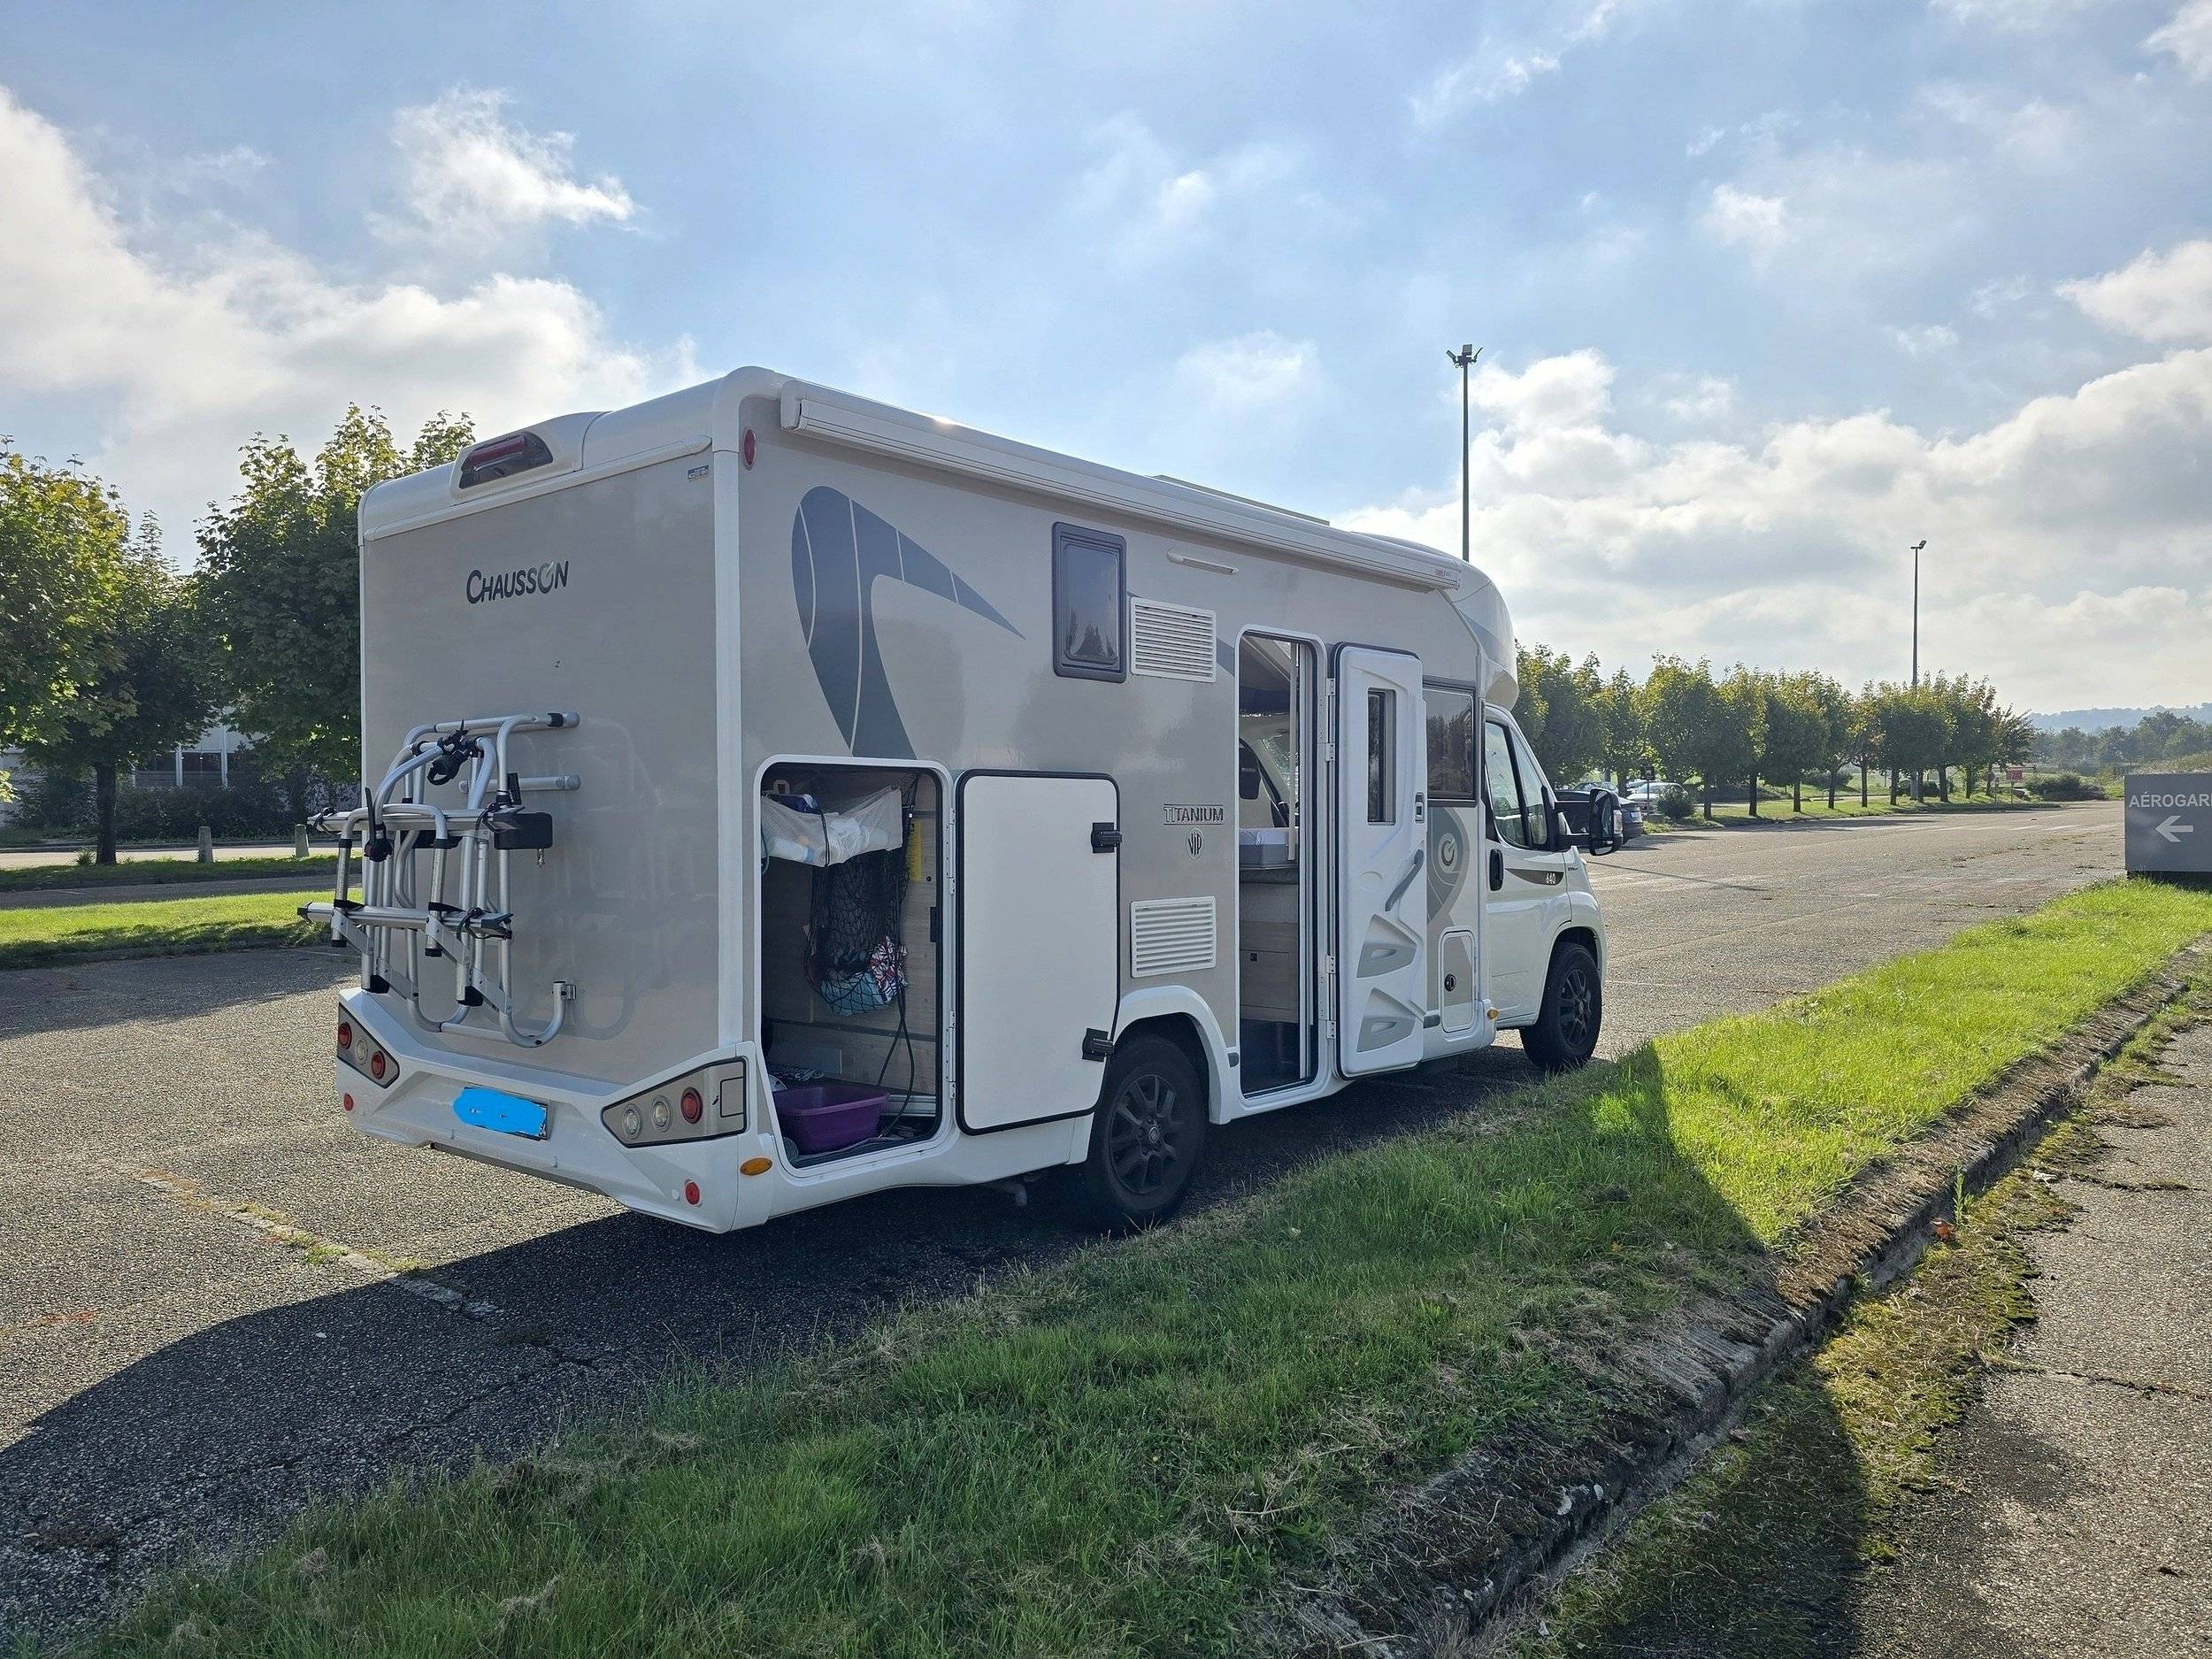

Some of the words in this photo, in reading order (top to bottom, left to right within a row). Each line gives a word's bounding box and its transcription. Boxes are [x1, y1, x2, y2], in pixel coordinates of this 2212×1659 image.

[466, 561, 569, 604] CHAUSSON
[2129, 791, 2212, 808] AÉROGAR
[1164, 806, 1224, 823] TITANIUM
